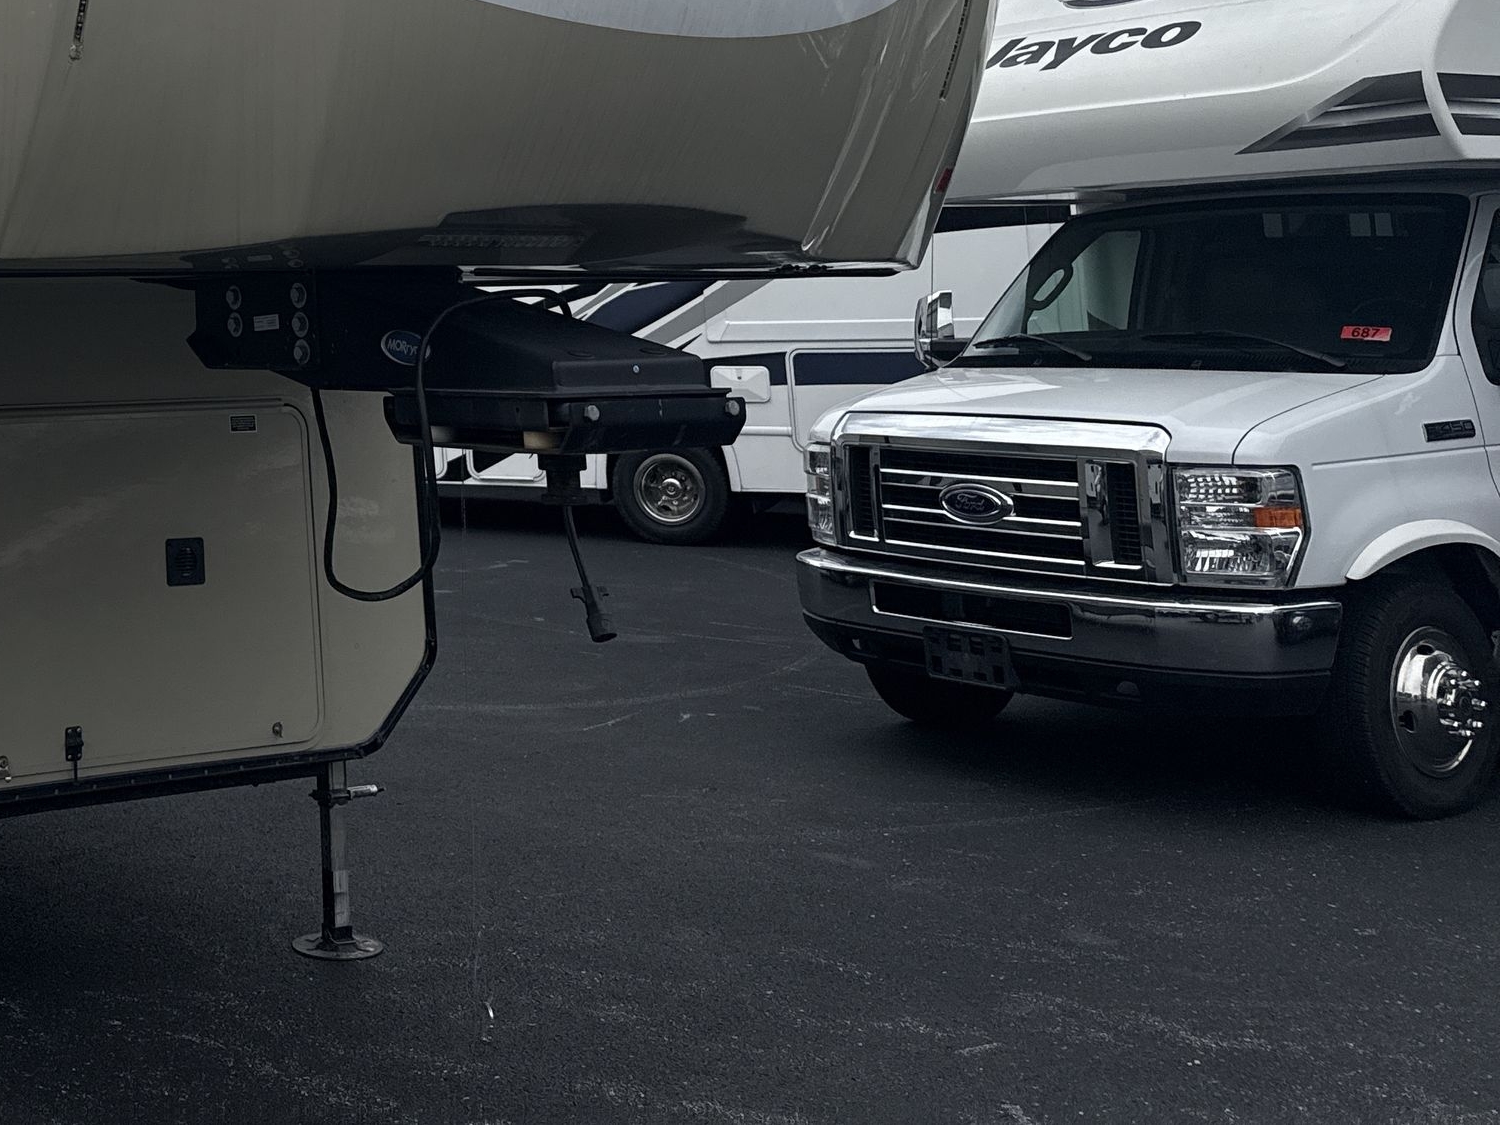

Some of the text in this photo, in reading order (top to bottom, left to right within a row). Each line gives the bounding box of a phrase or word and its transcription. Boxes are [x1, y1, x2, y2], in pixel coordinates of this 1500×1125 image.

[985, 21, 1202, 71] Jayco
[1351, 327, 1380, 338] 687
[955, 493, 985, 511] Ford
